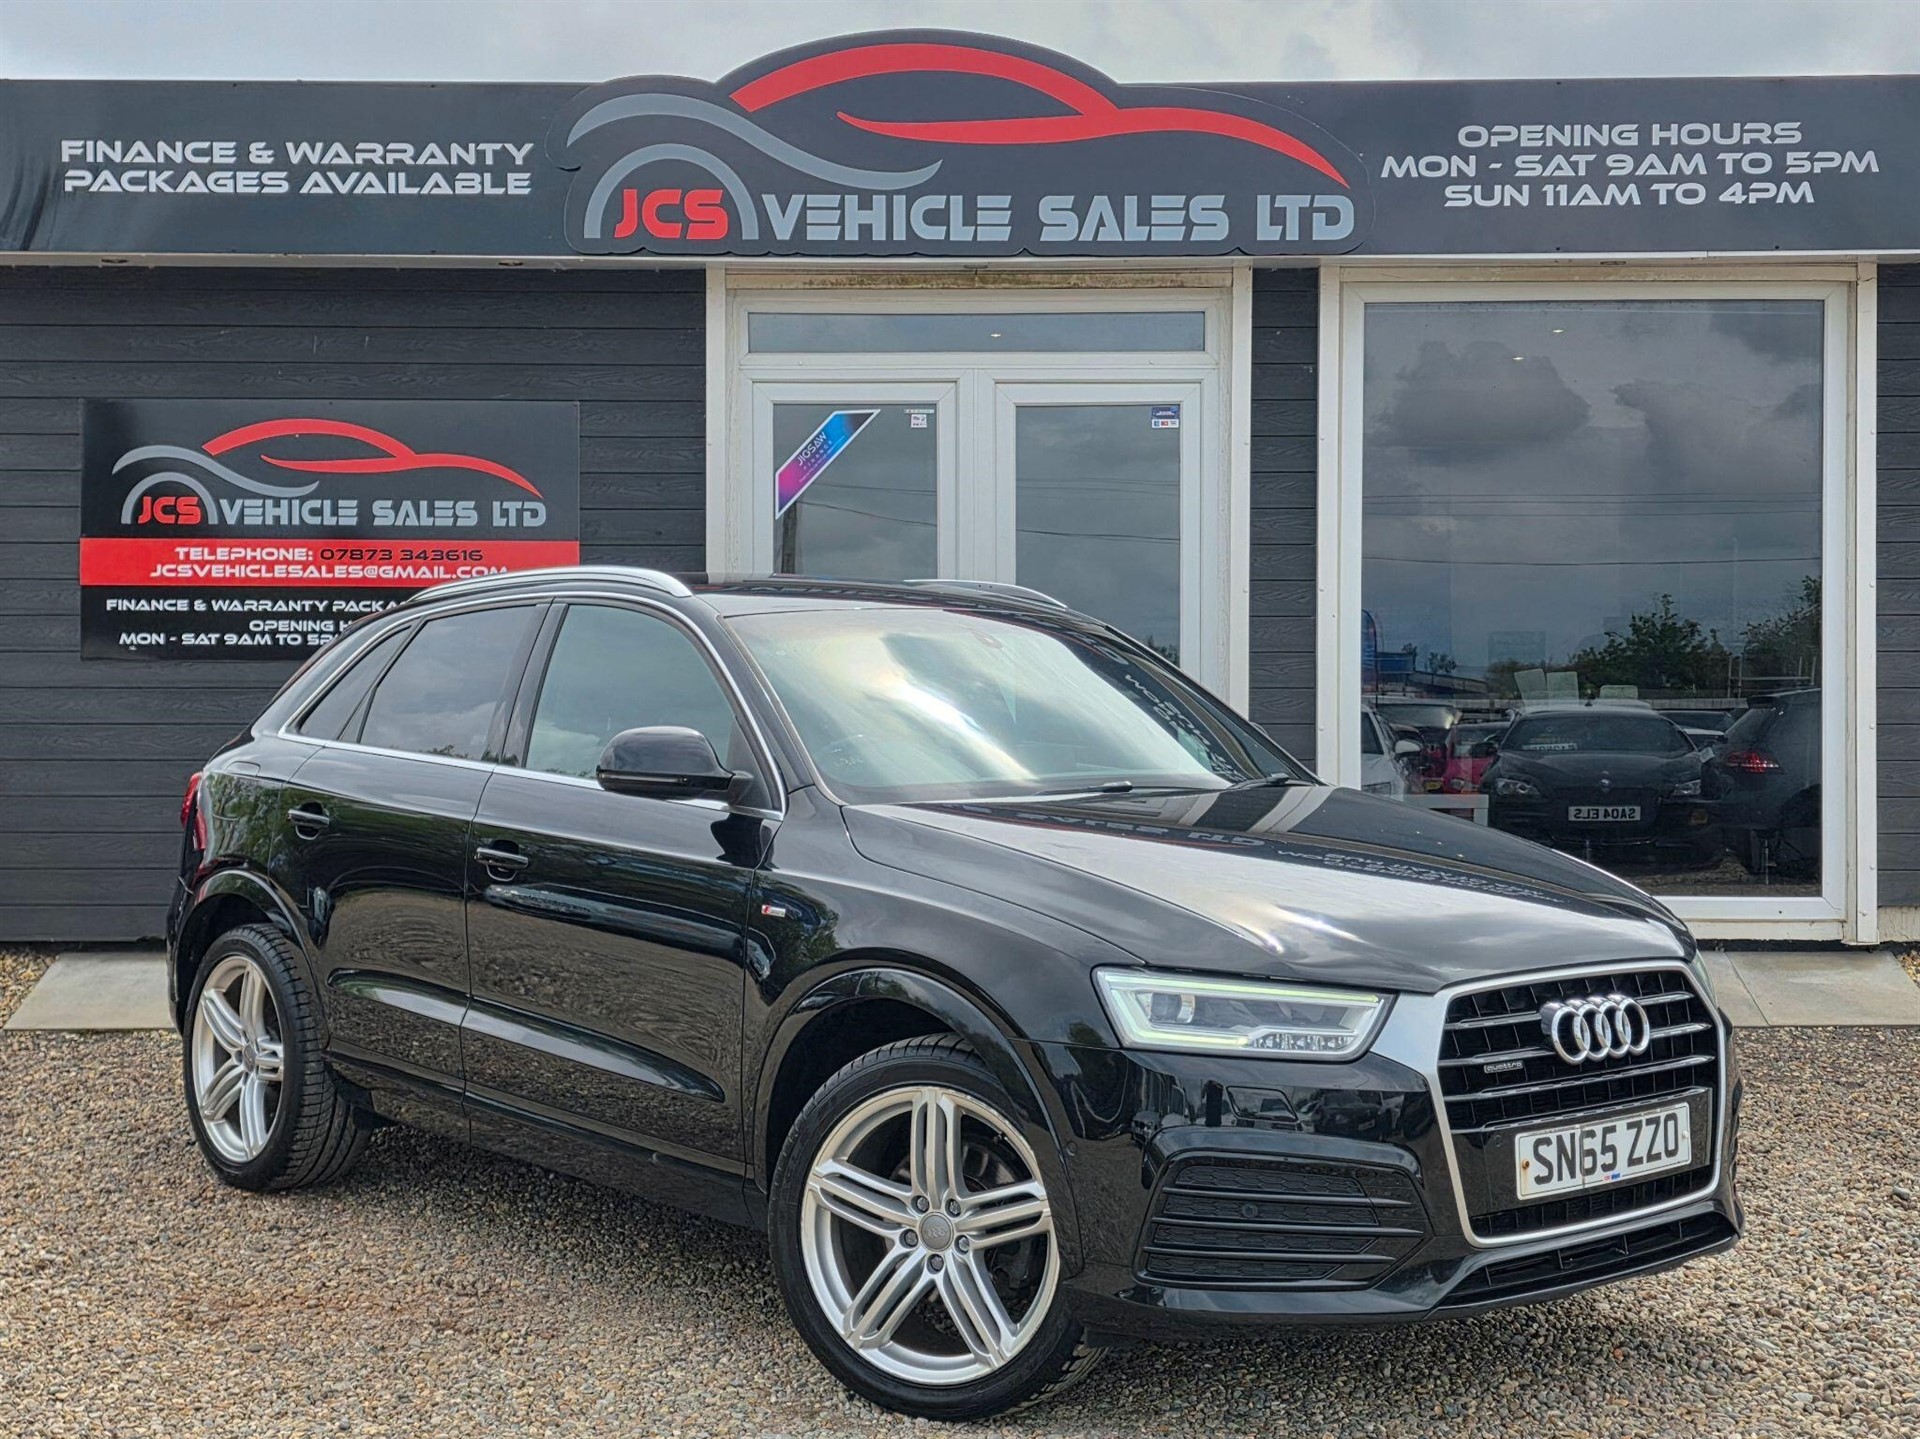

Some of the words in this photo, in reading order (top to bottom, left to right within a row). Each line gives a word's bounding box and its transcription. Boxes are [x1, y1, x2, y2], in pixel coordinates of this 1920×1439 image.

[1457, 123, 1639, 148] OPENING
[1651, 121, 1802, 146] HOURS
[61, 140, 237, 164] FINANCE
[248, 141, 275, 164] &
[285, 141, 534, 166] WARRANTY
[1380, 154, 1477, 178] MON
[1514, 154, 1597, 177] SAT
[1605, 152, 1708, 176] 9AM
[1716, 152, 1773, 175] TO
[1785, 150, 1880, 174] 5PM
[64, 169, 290, 194] PACKAGES
[299, 171, 532, 195] AVAILABLE
[1444, 184, 1530, 207] SUN
[1541, 183, 1642, 207] 11AM
[1649, 182, 1707, 205] TO
[1718, 181, 1815, 205] 4PM
[614, 188, 729, 241] JCS
[761, 193, 1012, 242] VEHICLE
[1038, 194, 1230, 242] SALES
[1256, 194, 1355, 241] LTD
[798, 431, 827, 466] JIGSAW
[138, 496, 202, 525] JCS
[219, 499, 358, 526] VEHICLE
[372, 499, 478, 527] SALES
[492, 500, 548, 527] LTD
[174, 546, 313, 561] TELEPHONE:
[320, 548, 393, 561] 07873
[399, 549, 484, 562] 343616
[150, 565, 508, 579] JCSVEHICLESALES@GMAIL.COM
[106, 598, 189, 612] FINANCE
[193, 599, 207, 612] &
[211, 599, 329, 613] WARRANTY
[248, 619, 334, 632] OPENING
[118, 632, 166, 645] MON
[181, 632, 221, 645] SAT
[223, 633, 272, 646] 9AM
[275, 633, 302, 646] TO
[307, 634, 339, 646] 5P
[1532, 1124, 1618, 1186] SN65
[1625, 1112, 1679, 1168] ZZO
